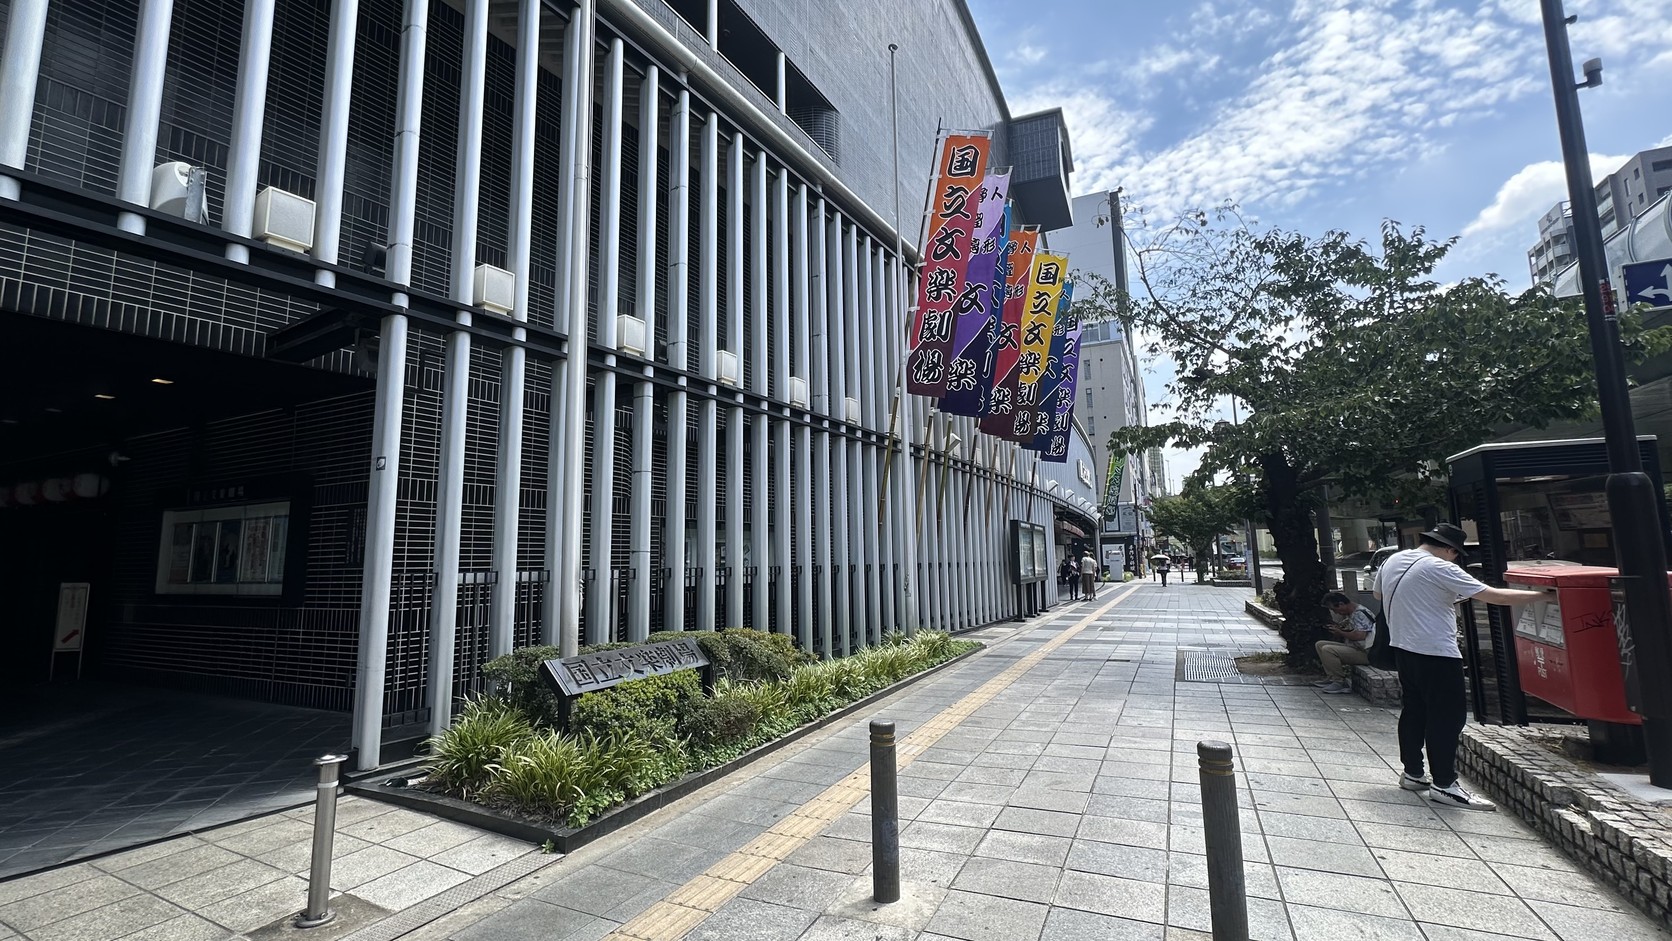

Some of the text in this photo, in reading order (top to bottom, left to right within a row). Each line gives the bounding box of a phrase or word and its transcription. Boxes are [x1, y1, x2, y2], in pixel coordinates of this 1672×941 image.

[912, 144, 980, 384] 国立文楽劇場
[983, 186, 1003, 254] 人形
[1014, 241, 1032, 298] 人形
[946, 282, 988, 391] 文楽
[989, 323, 1019, 414] 文楽
[1013, 262, 1060, 436] 国立文楽劇場
